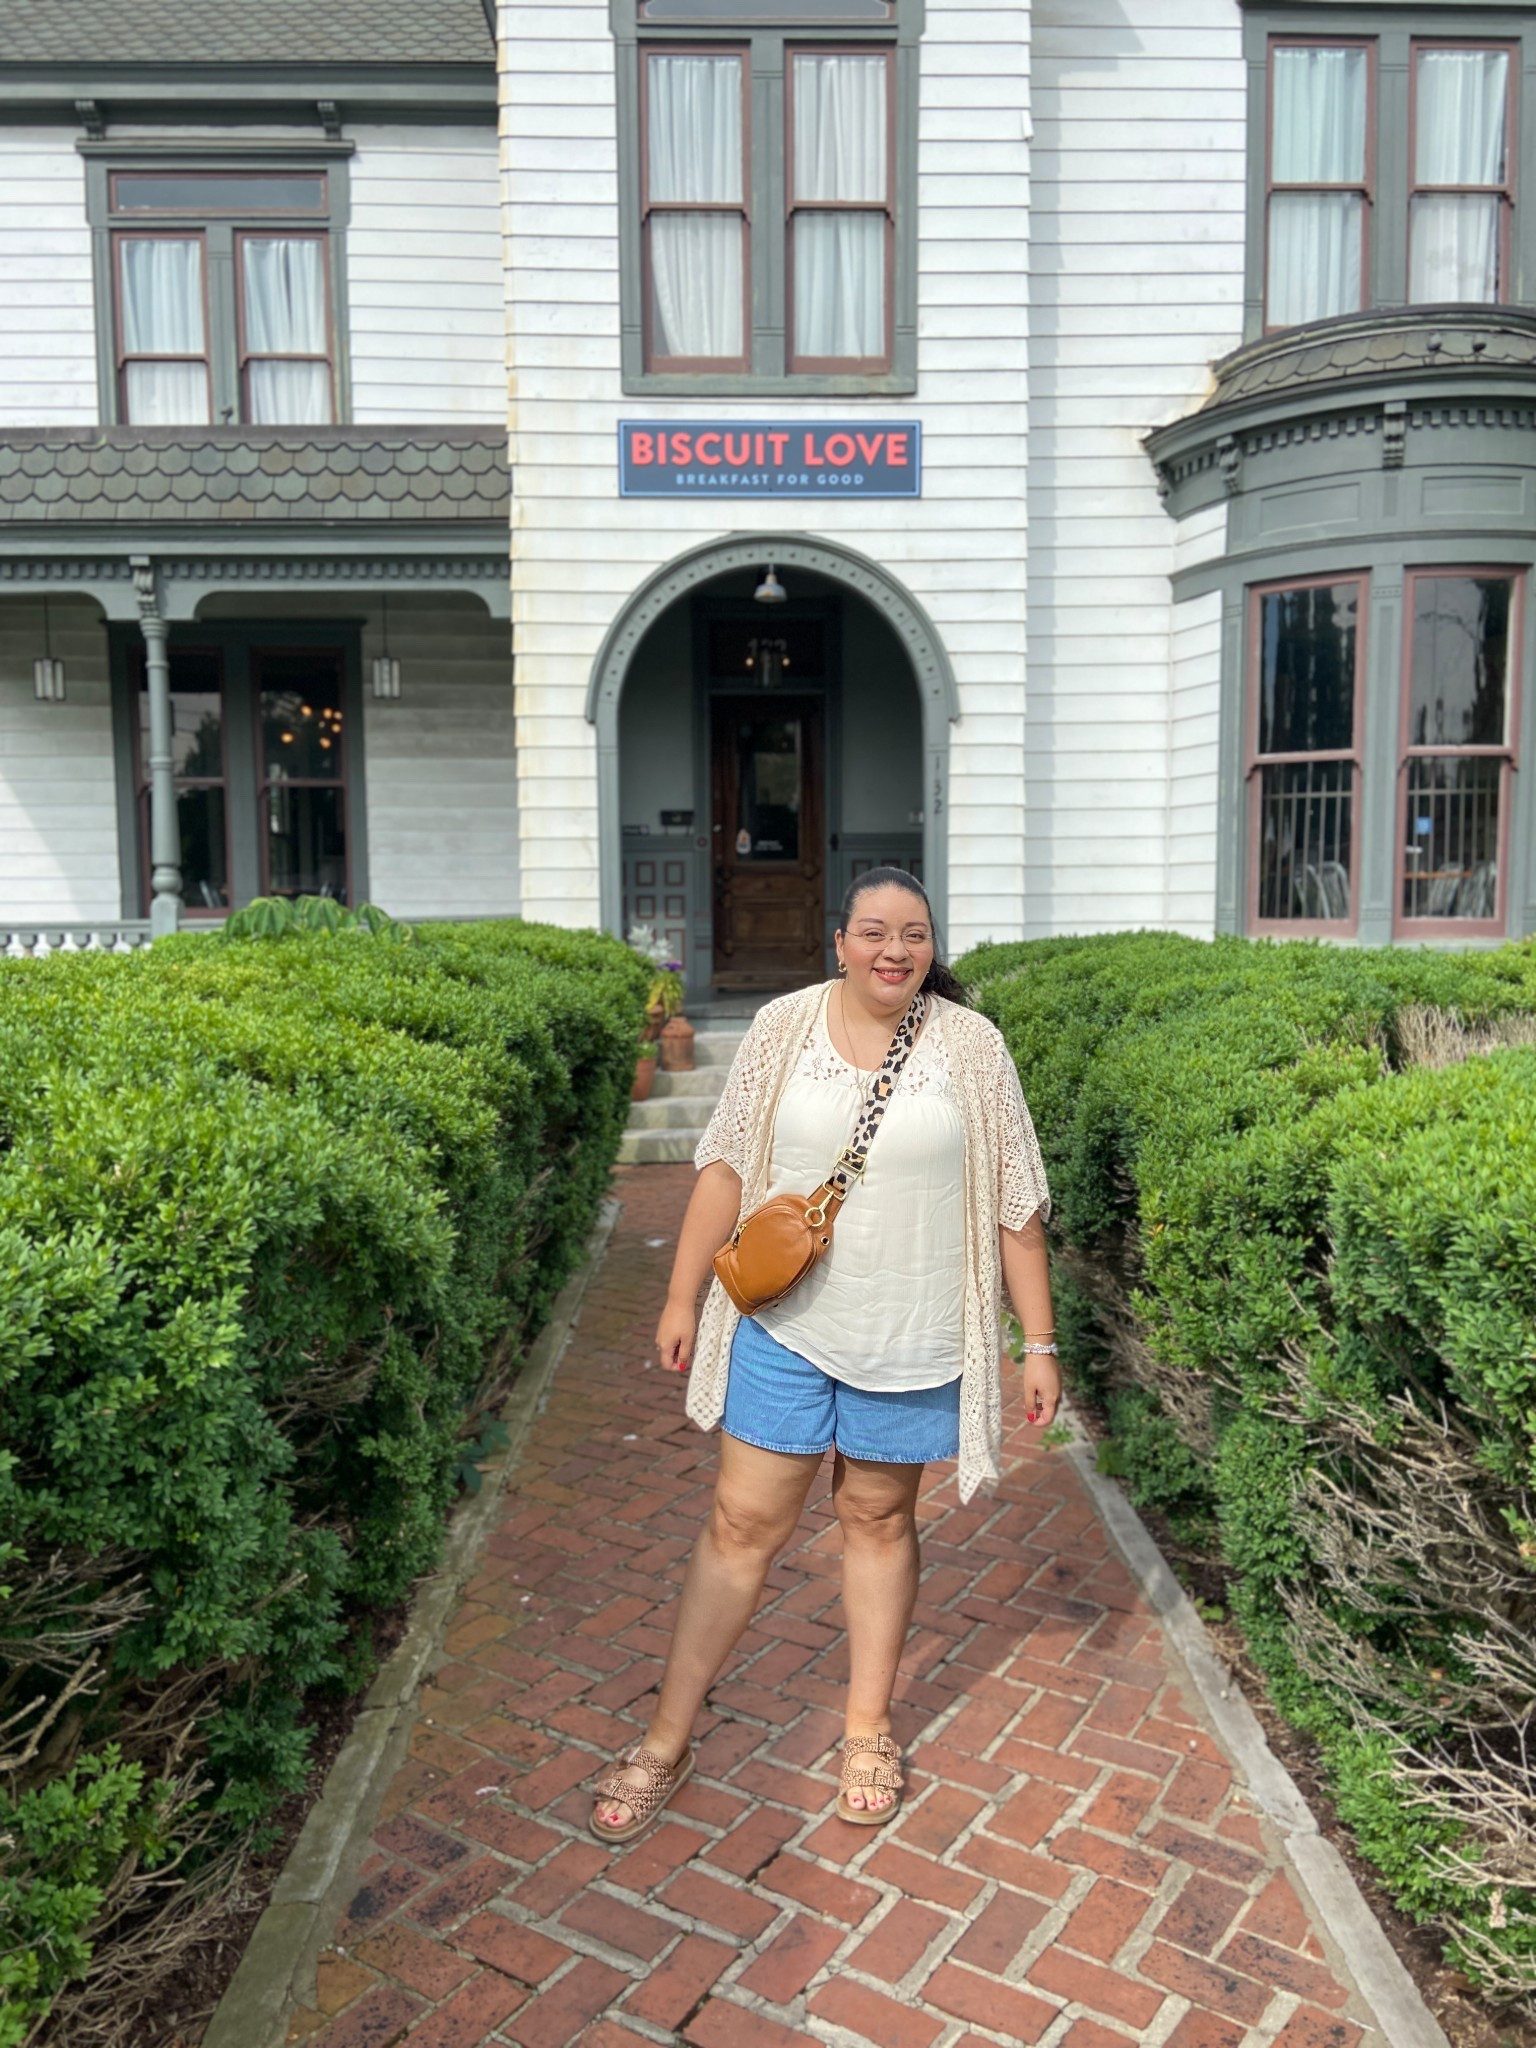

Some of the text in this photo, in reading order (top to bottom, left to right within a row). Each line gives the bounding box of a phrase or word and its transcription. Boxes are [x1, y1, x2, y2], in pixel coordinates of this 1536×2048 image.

[631, 432, 908, 467] BISCUIT LOVE
[675, 473, 863, 486] BREAKFAST FOR GOOD
